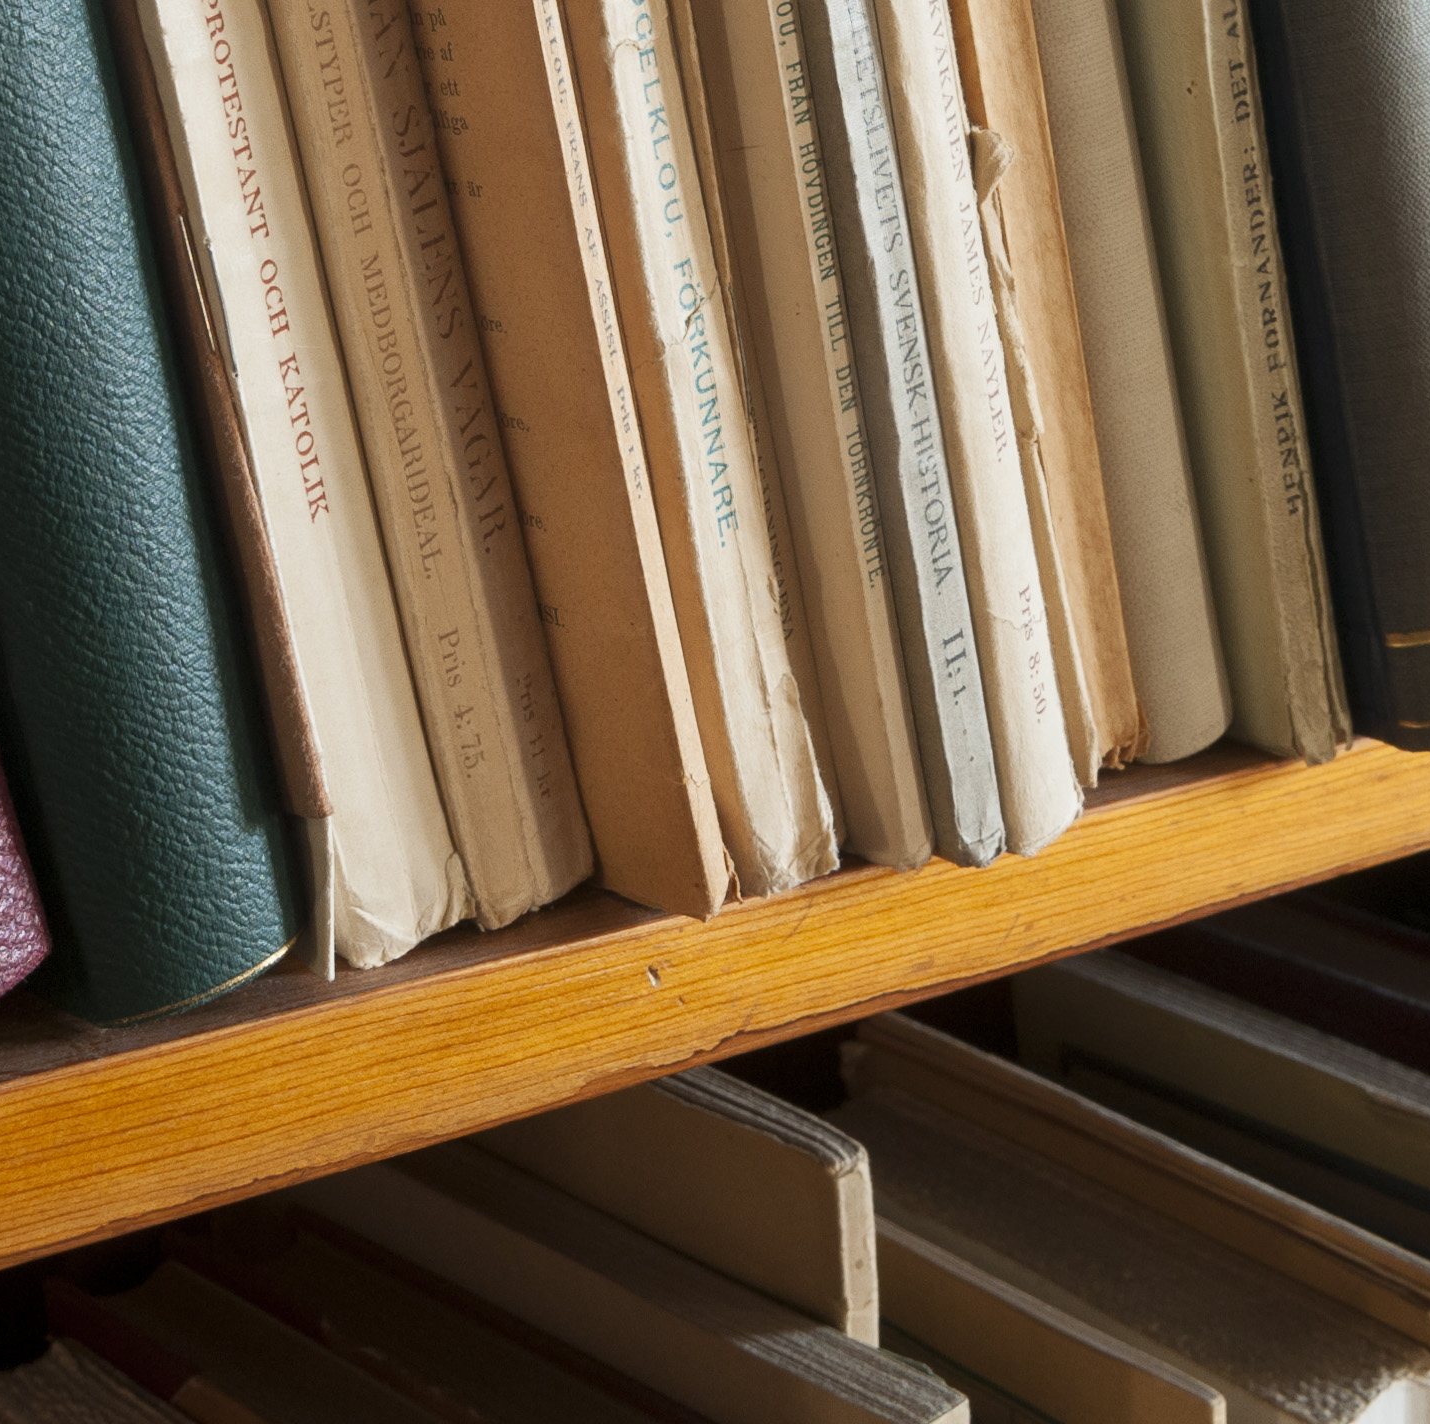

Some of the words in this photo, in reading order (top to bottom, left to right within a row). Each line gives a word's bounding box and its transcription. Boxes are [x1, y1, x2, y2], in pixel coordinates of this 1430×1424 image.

[427, 7, 448, 33] på
[785, 59, 813, 127] FRÅN
[1227, 58, 1252, 125] DET
[798, 140, 837, 283] HÖVDINGEN
[1242, 145, 1287, 374] FORNANDER:
[259, 257, 291, 340] OCH
[277, 351, 330, 525] KATOLIK
[392, 103, 468, 340] SJÄLENS
[448, 359, 507, 556] VÄGAR.
[672, 256, 741, 549] FÖRKUNNARE.
[824, 293, 845, 353] TILL
[834, 363, 857, 416] DEN
[340, 161, 374, 239] OCH
[359, 252, 446, 581] MEDBORGARIDEAL.
[437, 626, 466, 689] Pris
[846, 421, 886, 592] TÖRNKRÖNTE.
[958, 200, 986, 308] JAMES
[976, 322, 1008, 464] NAYLER.
[1018, 584, 1036, 642] Pris
